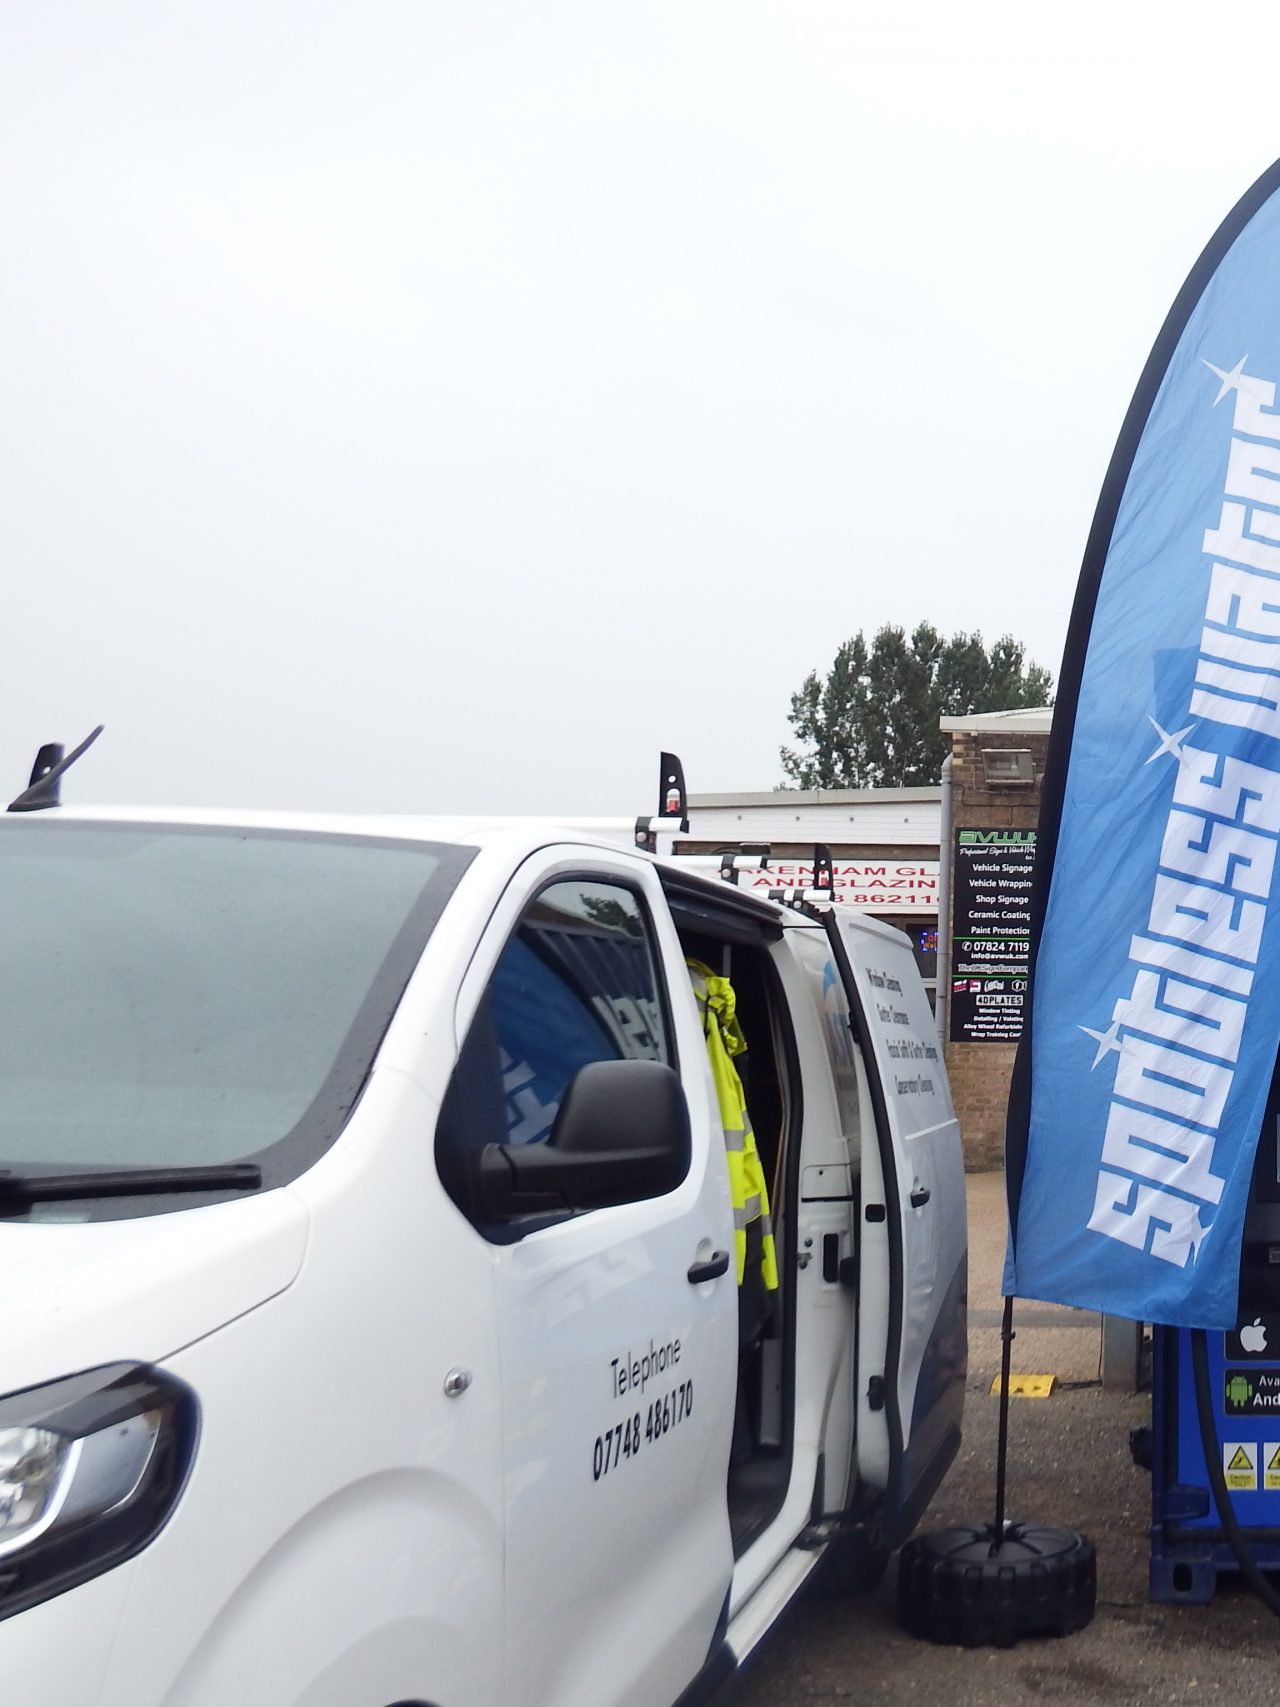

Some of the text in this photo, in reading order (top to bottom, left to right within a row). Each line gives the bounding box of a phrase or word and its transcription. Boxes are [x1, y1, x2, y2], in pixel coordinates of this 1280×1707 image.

[895, 867, 940, 876] GL
[973, 863, 1033, 874] Vehicle Signage
[832, 878, 936, 888] GLAZIN
[969, 879, 997, 888] Vehicle
[854, 893, 940, 904] 86211
[975, 894, 1029, 905] Shop Signage
[968, 910, 1000, 919] Ceramic
[970, 926, 991, 934] Paint
[973, 941, 1030, 952] 07824 7119
[977, 996, 1022, 1005] 4DPLATES
[611, 1338, 682, 1399] Telephone
[593, 1378, 693, 1482] 07748 486170
